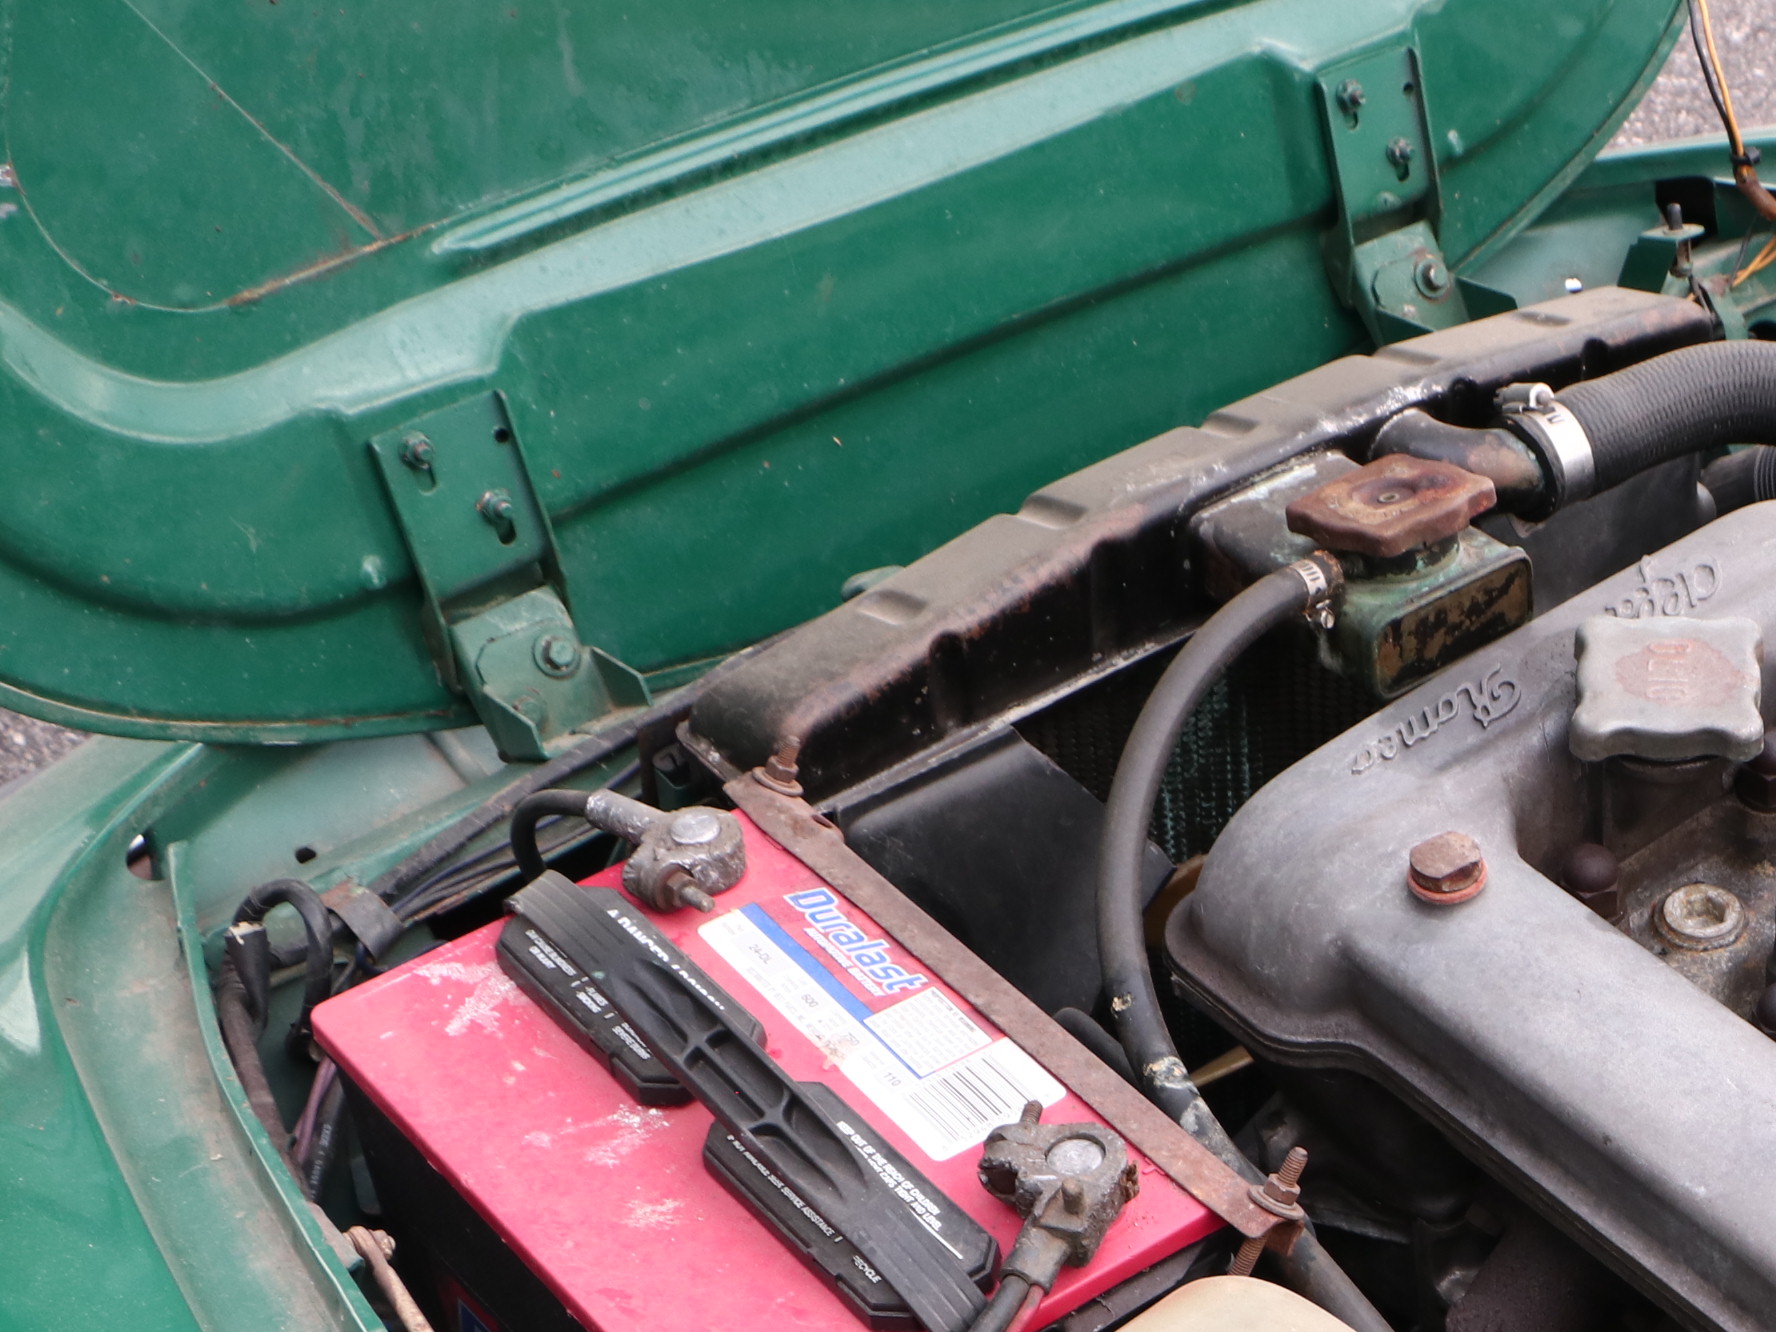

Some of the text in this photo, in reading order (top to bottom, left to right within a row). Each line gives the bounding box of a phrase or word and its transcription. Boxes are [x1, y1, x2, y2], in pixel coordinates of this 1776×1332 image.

[1352, 667, 1522, 775] Romeo
[782, 885, 929, 995] Duralast
[846, 966, 886, 997] BATTERY
[882, 1071, 902, 1088] 110
[835, 1120, 856, 1137] KEEP
[849, 1133, 867, 1148] OUT
[861, 1144, 876, 1155] OF
[870, 1152, 888, 1166] THE
[881, 1163, 905, 1183] REACH
[899, 1179, 914, 1191] OF
[908, 1187, 941, 1216] CHILDREN
[779, 1186, 805, 1209] SERVICE
[799, 1205, 835, 1237] ASSISTANCE
[878, 1171, 897, 1188] CAPS
[893, 1186, 915, 1204] TIGHT
[908, 1200, 927, 1215] AND
[920, 1211, 943, 1232] LEVEL
